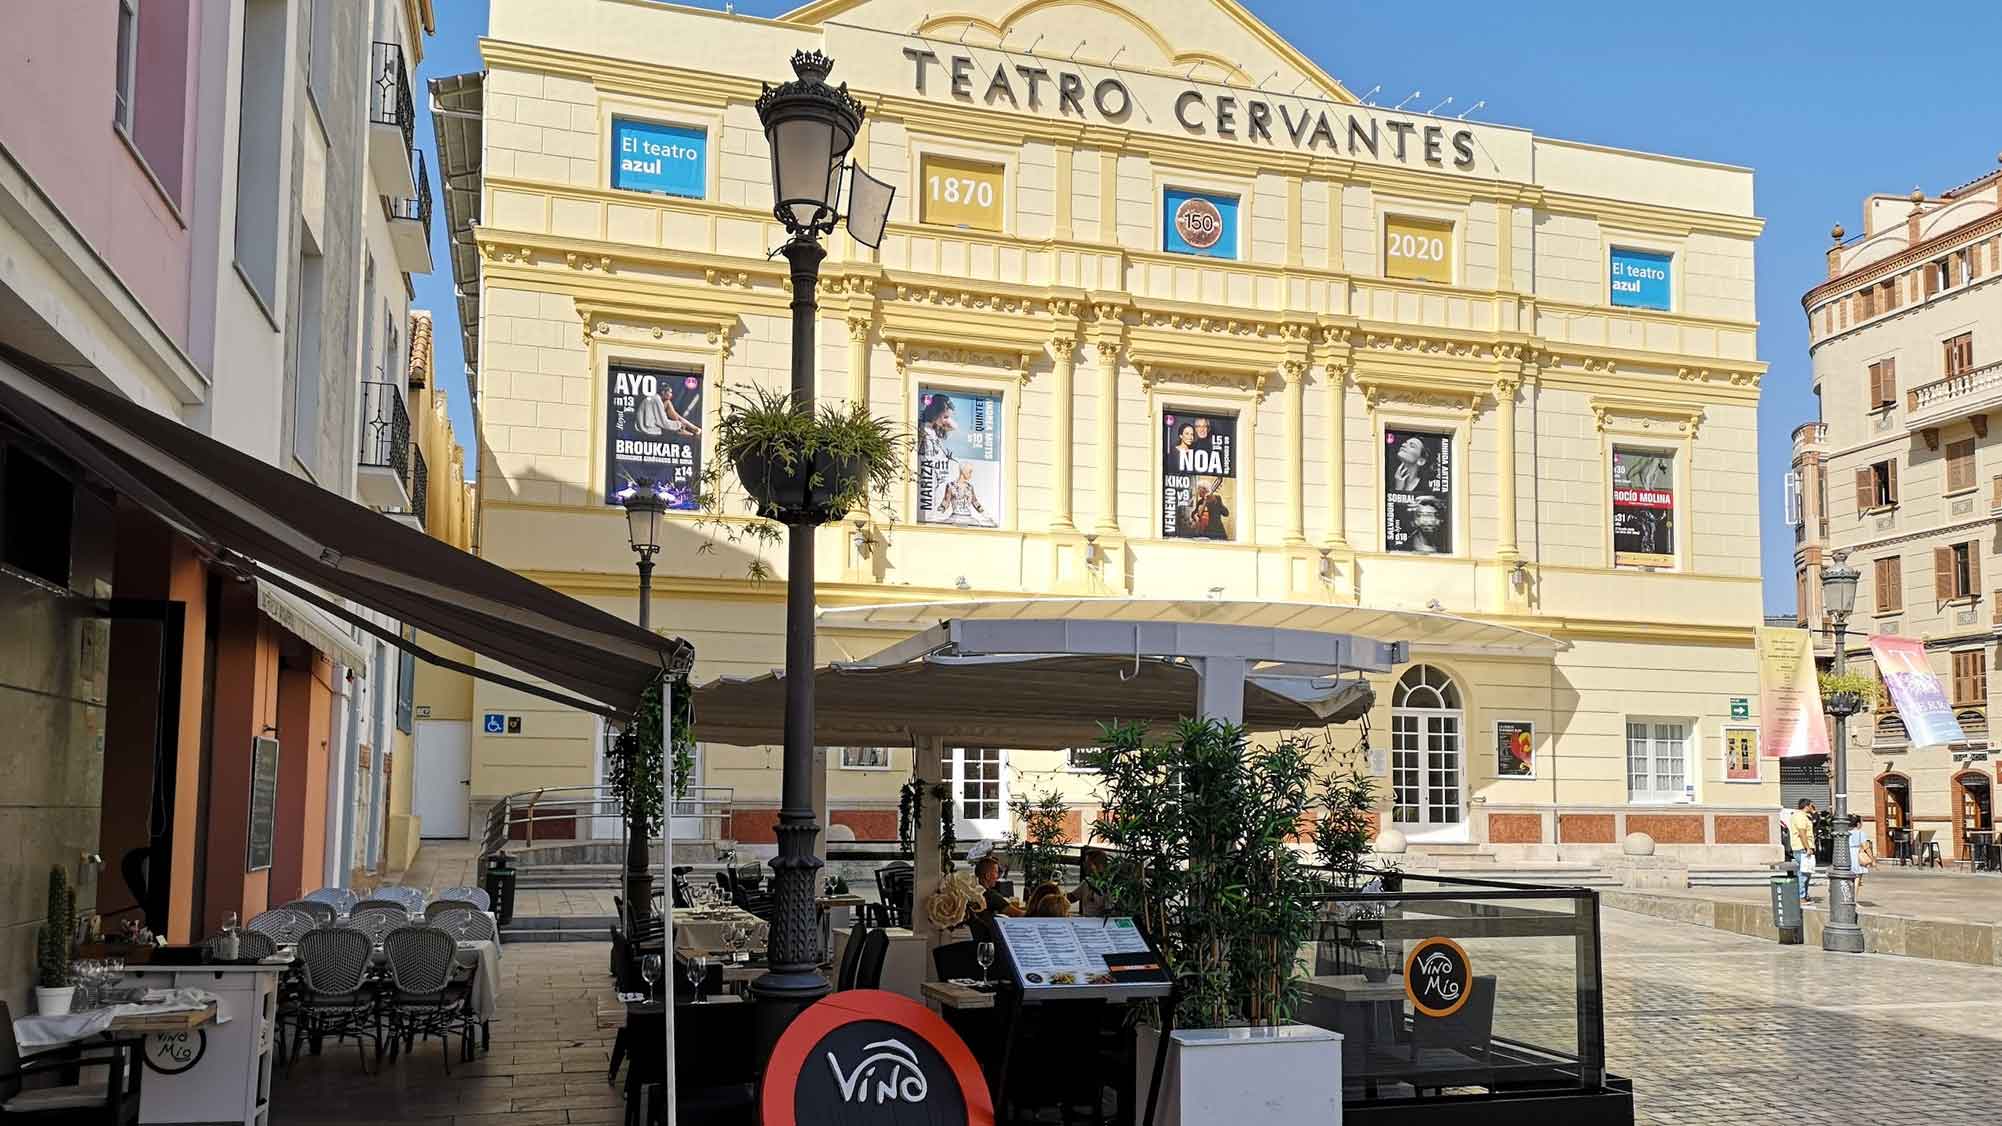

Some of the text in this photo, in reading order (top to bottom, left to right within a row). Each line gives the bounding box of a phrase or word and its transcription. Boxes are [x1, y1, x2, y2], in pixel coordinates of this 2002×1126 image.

[902, 47, 1474, 168] TEATRO CERVANTES
[622, 136, 697, 160] El teatro
[622, 159, 662, 175] azul
[929, 175, 993, 208] 1870
[1184, 212, 1213, 232] 150
[1389, 233, 1444, 261] 2020
[1612, 262, 1665, 281] El teatro
[1612, 280, 1641, 293] azul
[614, 373, 657, 397] AYO
[613, 396, 635, 407] m13
[616, 440, 692, 458] BROUKAR &
[1211, 434, 1223, 445] L5
[1179, 448, 1223, 474] NOA
[675, 466, 693, 477] x14
[920, 460, 933, 511] MARIZA
[1164, 475, 1190, 488] KIKO
[1640, 492, 1671, 504] MOLINA
[1165, 488, 1176, 532] VENENO
